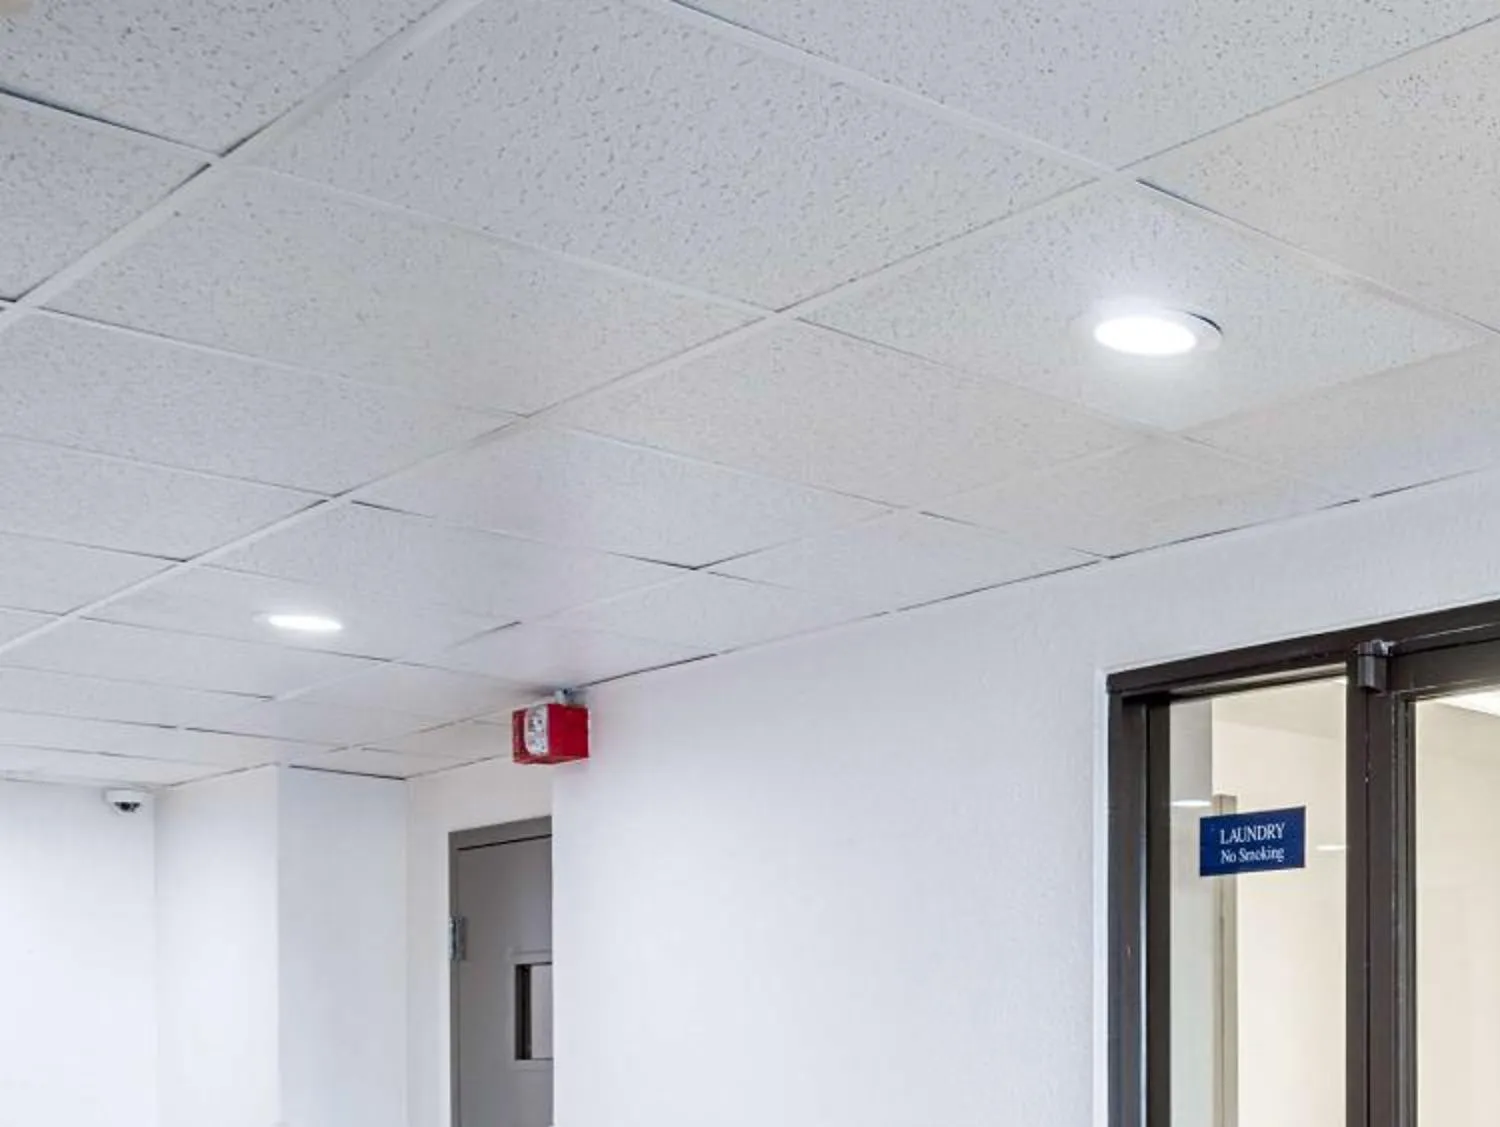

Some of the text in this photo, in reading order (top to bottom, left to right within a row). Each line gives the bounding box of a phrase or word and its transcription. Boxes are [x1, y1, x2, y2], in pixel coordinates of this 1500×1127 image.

[1220, 822, 1285, 844] LAUNDRY
[1220, 845, 1285, 864] No Smoking
